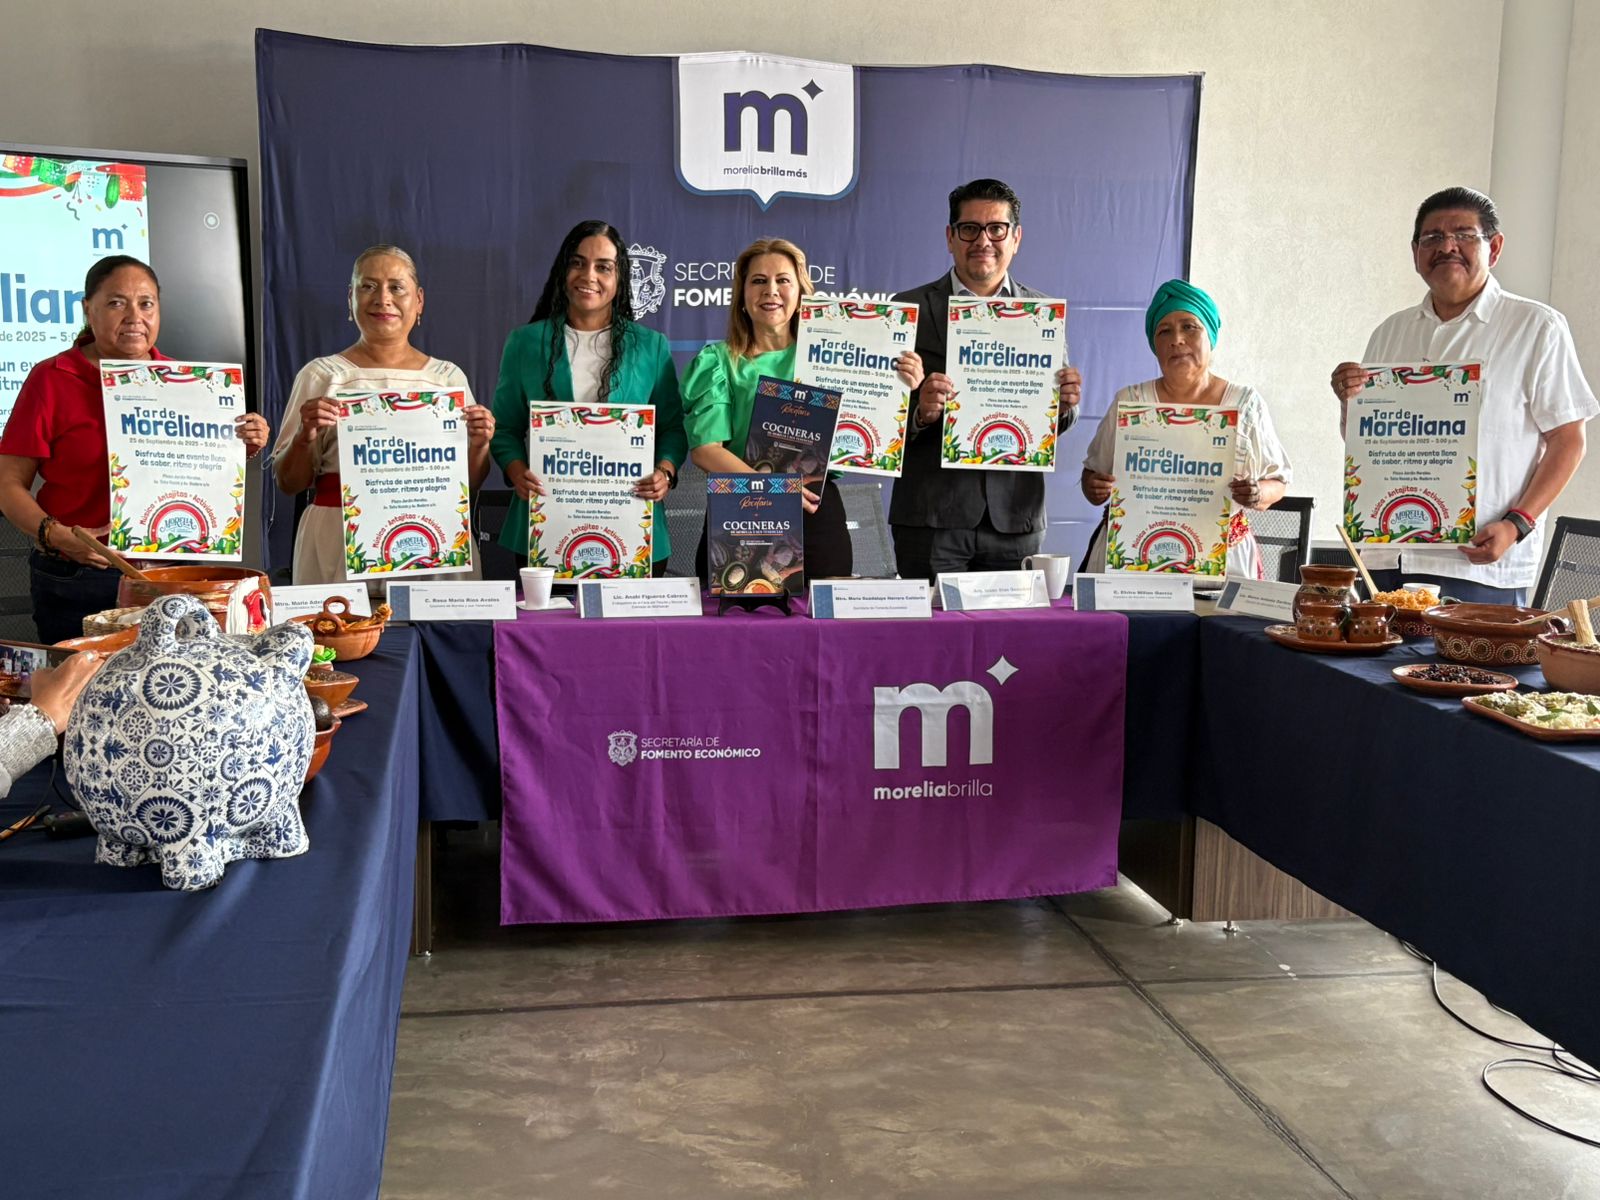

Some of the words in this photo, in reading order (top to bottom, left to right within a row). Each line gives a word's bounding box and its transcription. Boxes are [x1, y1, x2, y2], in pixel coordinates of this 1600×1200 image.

[724, 90, 808, 156] m
[809, 265, 836, 284] DE
[674, 288, 732, 306] FOME
[16, 331, 46, 342] 2025
[893, 331, 905, 341] m
[1042, 328, 1054, 338] m
[821, 337, 854, 351] Tarde
[971, 339, 1004, 350] Tarde
[959, 345, 1051, 368] Moreliana
[815, 375, 840, 384] Disfruta
[219, 396, 233, 406] m
[1454, 392, 1468, 402] m
[134, 405, 174, 419] Tarde
[982, 412, 1008, 422] Antojitos
[1373, 408, 1410, 419] Tarde
[121, 414, 233, 440] Moreliana
[443, 419, 456, 429] m
[860, 416, 881, 446] Actividades
[1360, 414, 1465, 436] Moreliana
[762, 422, 821, 441] COCINERAS
[365, 435, 403, 447] Tarde
[630, 435, 643, 446] m
[1212, 436, 1226, 446] m
[135, 449, 164, 457] Disfruta
[353, 441, 455, 465] Moreliana
[555, 447, 590, 459] Tarde
[1138, 446, 1172, 457] Tarde
[543, 454, 641, 477] Moreliana
[1125, 452, 1222, 476] Moreliana
[1387, 485, 1417, 497] Antojitos
[1422, 488, 1449, 518] Actividades
[157, 490, 187, 502] Antojitos
[193, 495, 217, 528] Actividades
[387, 513, 415, 525] Antojitos
[420, 515, 446, 543] Actividades
[723, 521, 790, 530] COCINERAS
[1148, 519, 1175, 529] Antojitos
[570, 523, 598, 534] Antojitos
[603, 526, 627, 556] Actividades
[874, 681, 994, 770] m
[641, 736, 702, 748] SECRETARÍA
[706, 736, 720, 746] DE
[641, 750, 692, 760] FOMENTO
[694, 746, 760, 758] ECONÓMICO
[874, 779, 992, 800] moreliabrilla
